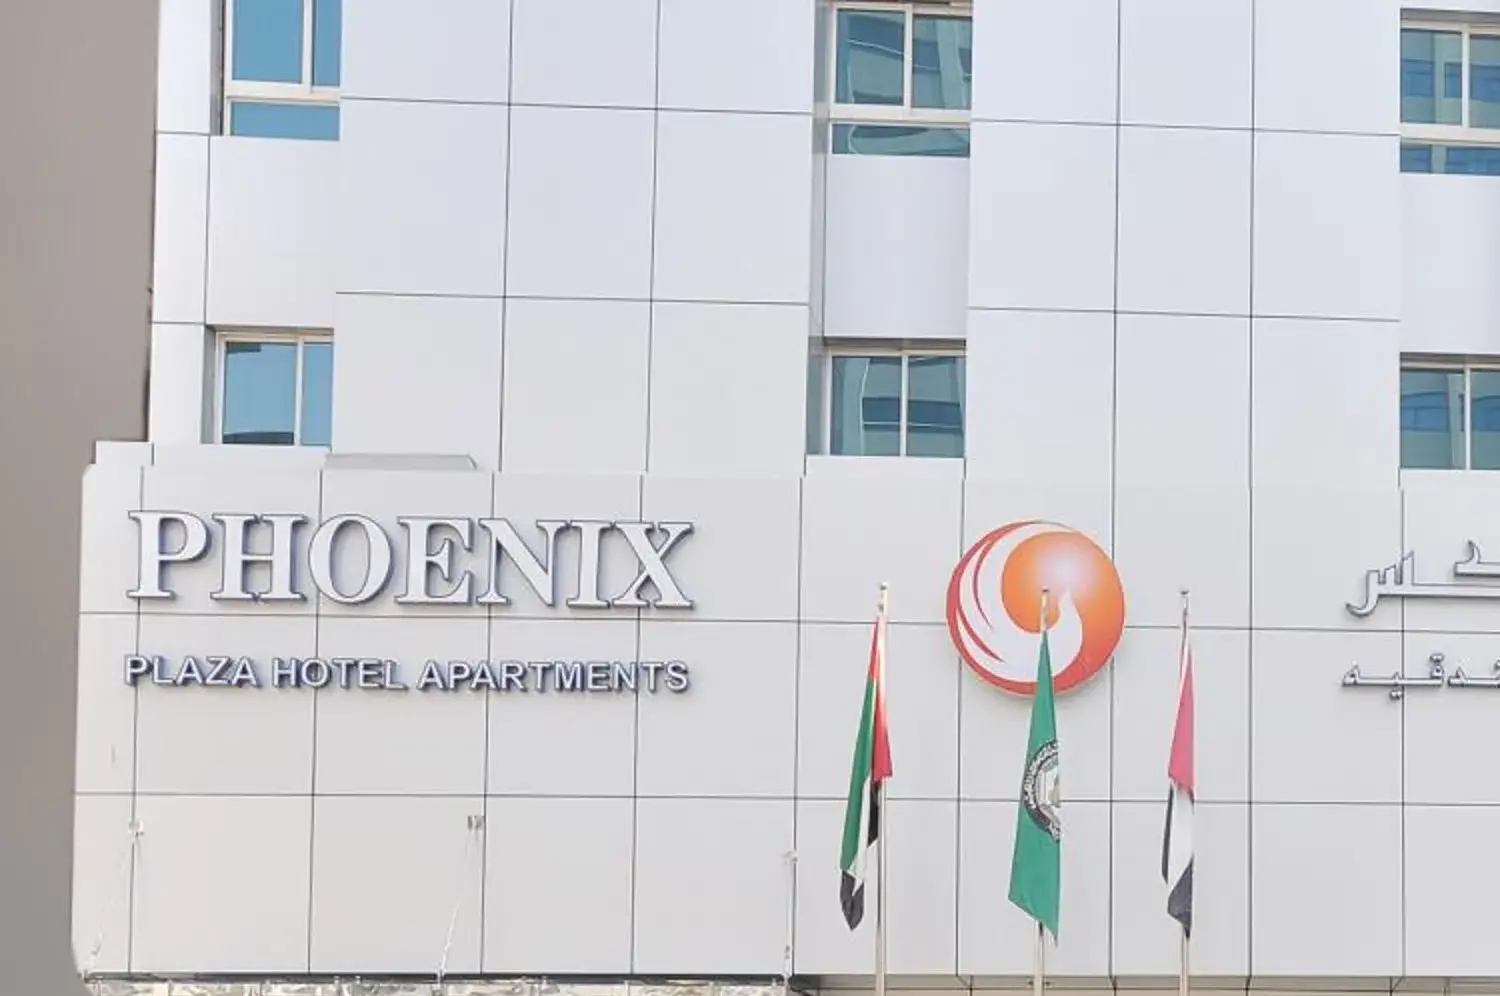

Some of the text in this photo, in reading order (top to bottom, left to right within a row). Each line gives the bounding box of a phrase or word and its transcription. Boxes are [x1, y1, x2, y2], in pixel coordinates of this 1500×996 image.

[127, 510, 695, 610] PHOENIX
[124, 655, 691, 693] PLAZA HOTEL APARTMENTS
